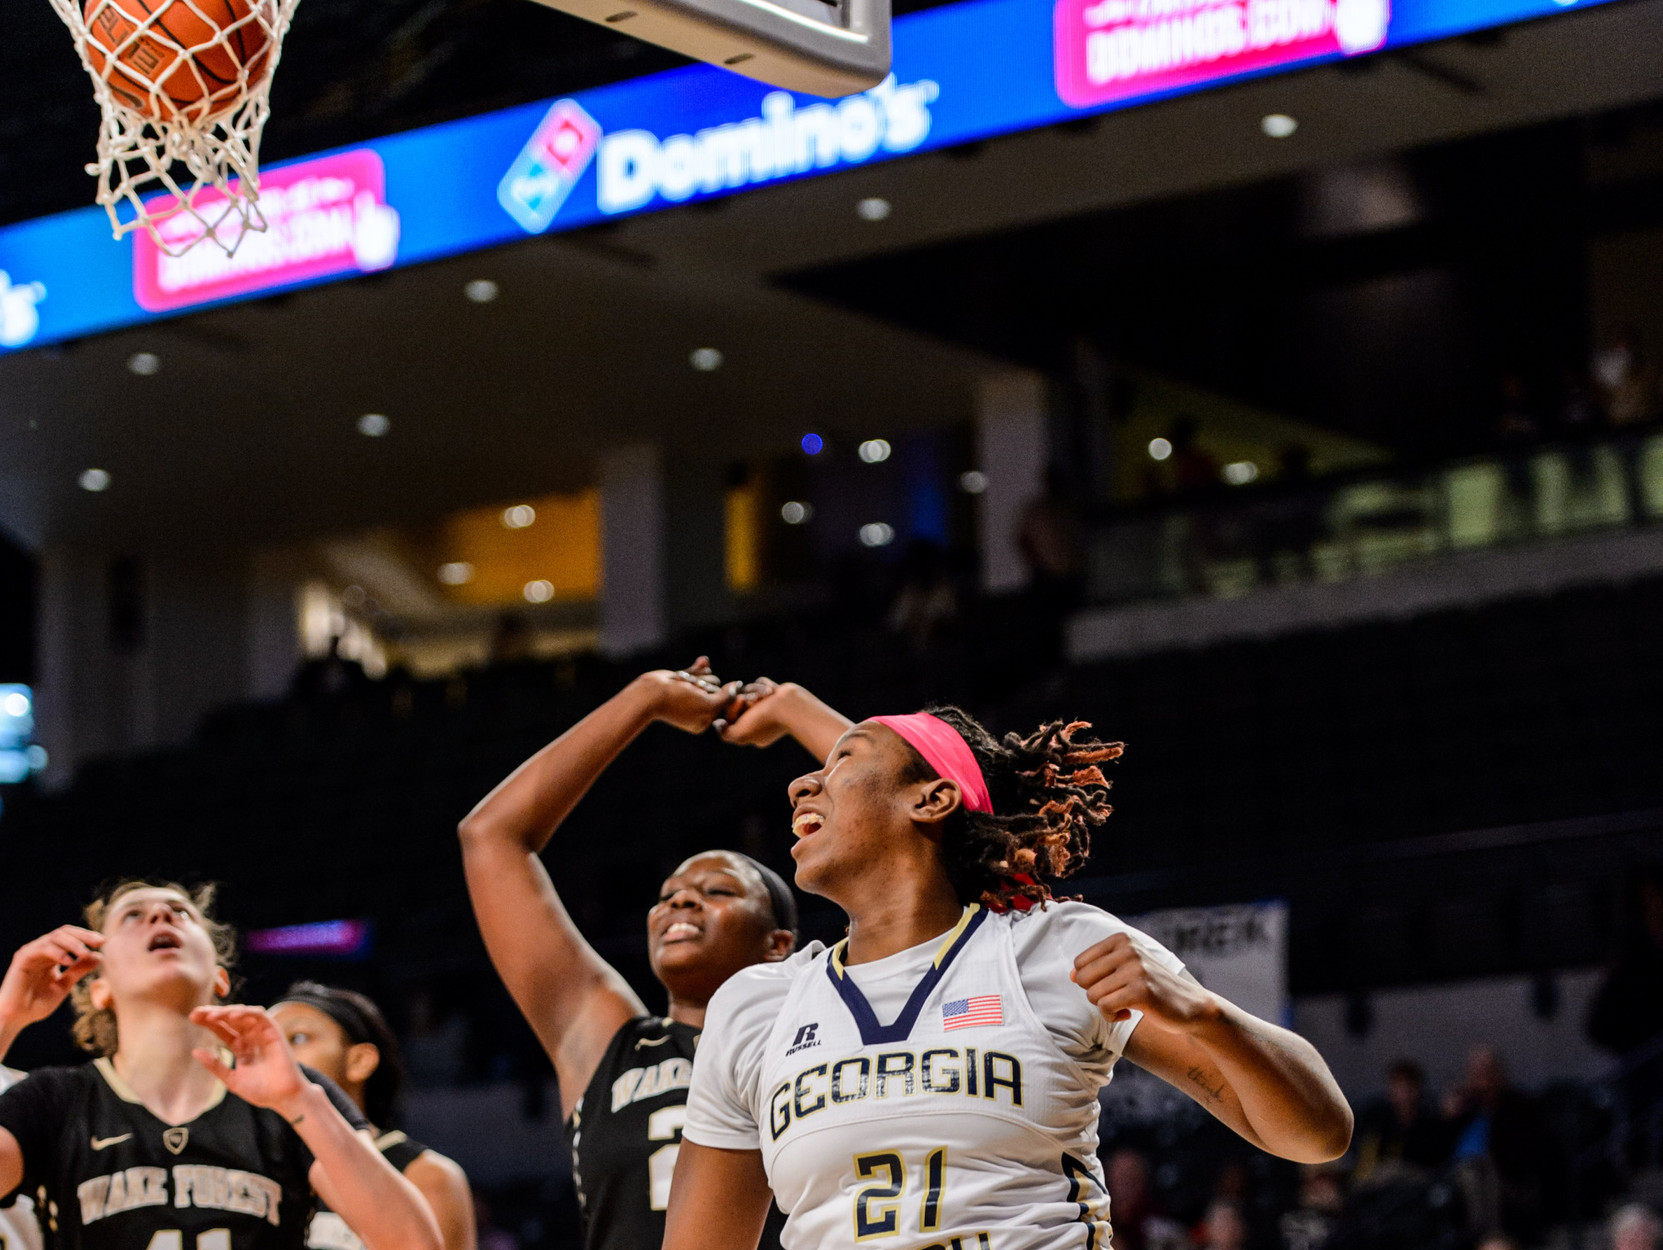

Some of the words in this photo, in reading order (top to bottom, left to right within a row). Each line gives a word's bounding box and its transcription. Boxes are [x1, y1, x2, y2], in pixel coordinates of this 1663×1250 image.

[785, 1039, 821, 1057] RUSSELL
[770, 1046, 1024, 1142] GEORGIA
[77, 1166, 169, 1226] WAKE
[172, 1164, 282, 1227] FOREST
[853, 1145, 948, 1243] 21
